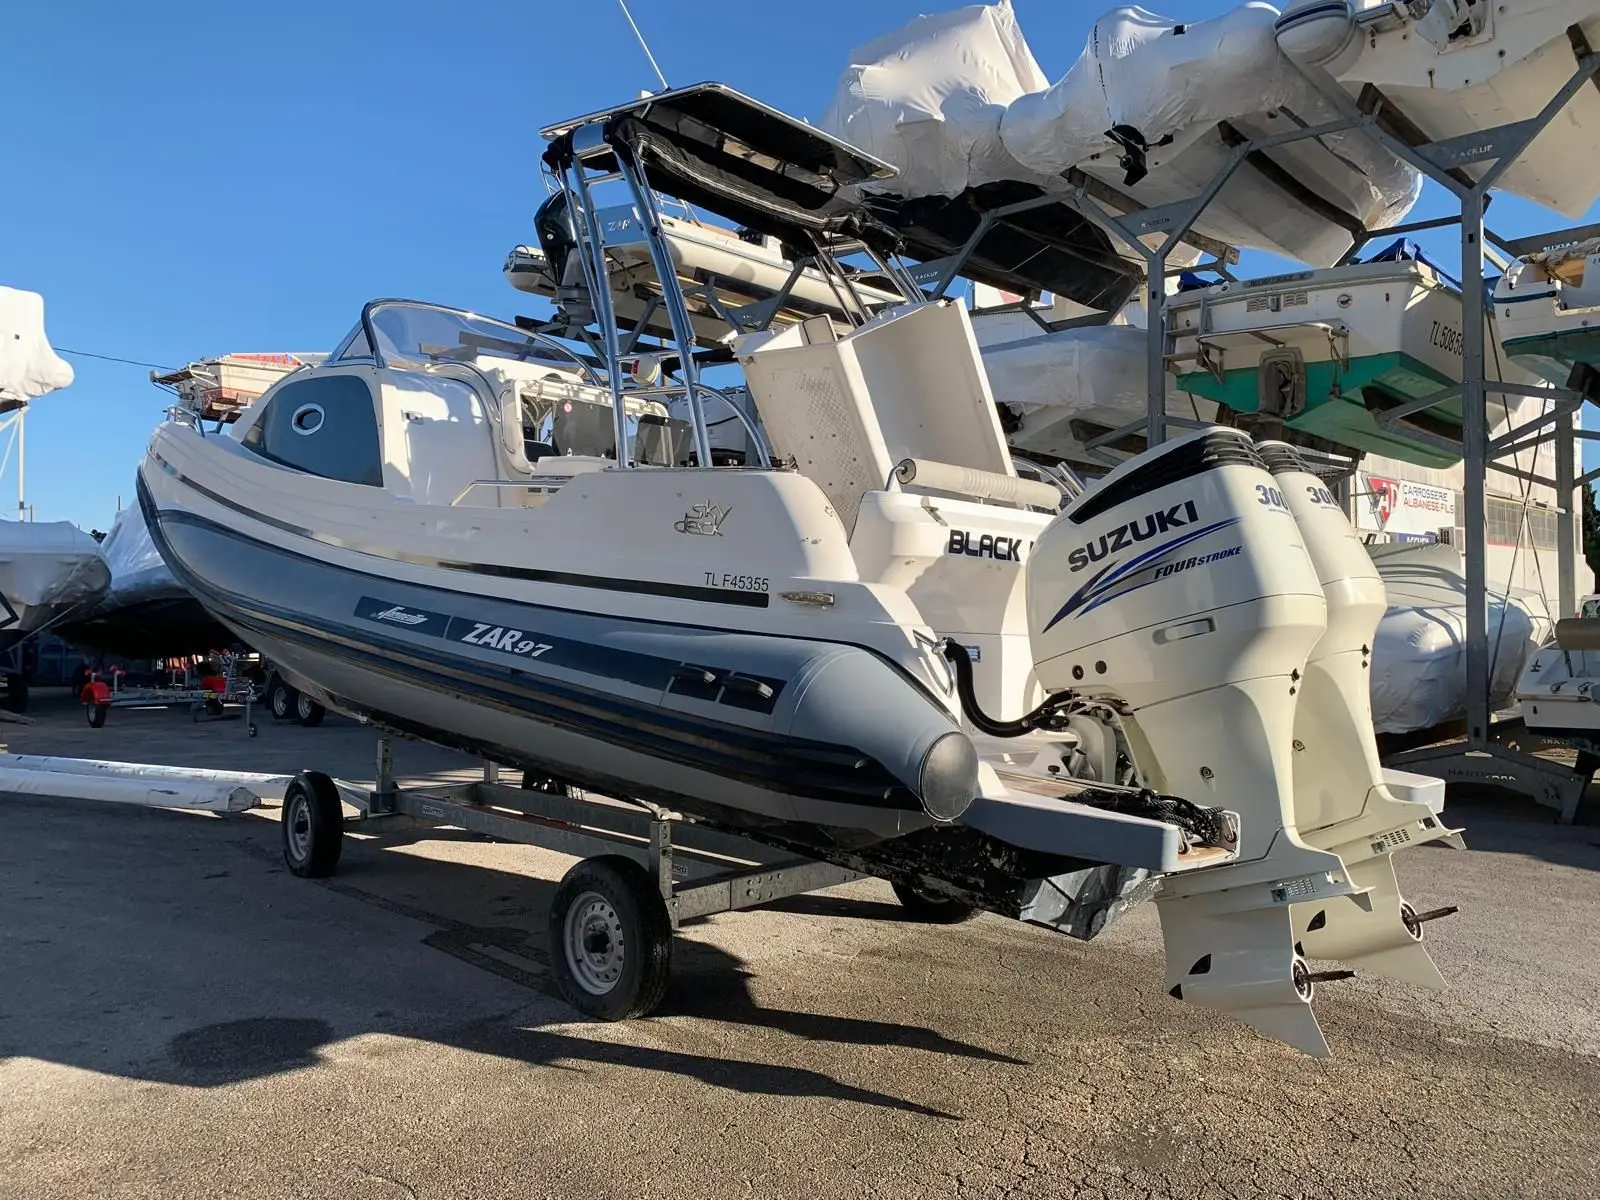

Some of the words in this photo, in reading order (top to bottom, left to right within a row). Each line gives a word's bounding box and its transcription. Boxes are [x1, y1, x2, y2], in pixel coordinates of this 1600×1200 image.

[1402, 484, 1448, 502] CARROSSERIE
[948, 529, 1022, 561] BLACK
[1068, 500, 1199, 572] SUZUKI
[704, 572, 718, 587] TL
[722, 574, 769, 592] F45355
